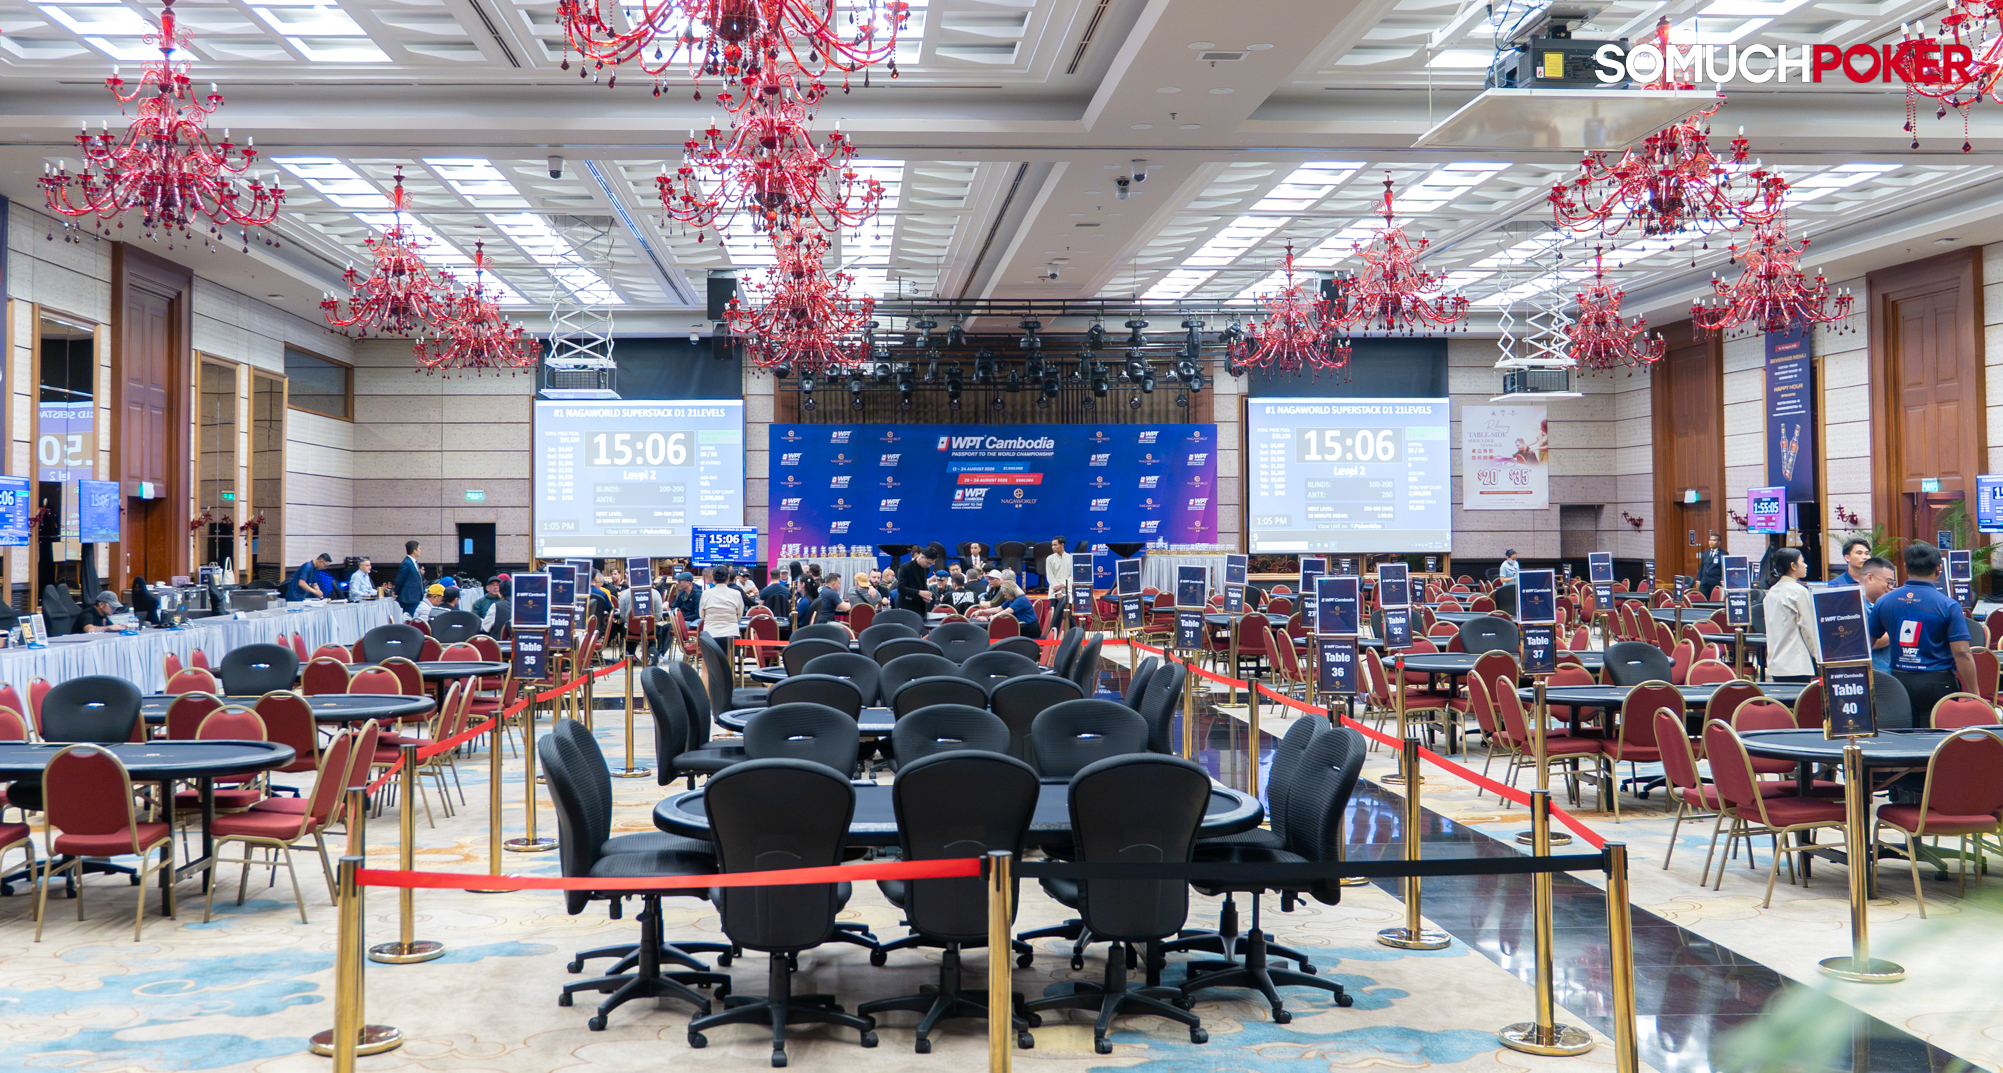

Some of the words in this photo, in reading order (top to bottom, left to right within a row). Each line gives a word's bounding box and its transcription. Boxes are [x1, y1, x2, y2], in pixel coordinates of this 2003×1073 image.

[554, 409, 564, 418] #1
[566, 409, 620, 418] NAGAWORLD
[622, 409, 673, 418] SUPERSTACK
[674, 409, 686, 418] D1
[687, 409, 725, 418] 21LEVELS
[1265, 406, 1276, 414] #1
[1277, 406, 1330, 414] NAGAWORLD
[1332, 406, 1381, 414] SUPERSTACK
[1383, 406, 1393, 414] D1
[1395, 406, 1431, 414] 21LEVELS
[952, 436, 985, 449] WPT
[986, 436, 1055, 449] Cambodia
[1304, 430, 1395, 461] 15:06
[593, 433, 687, 466] 15:06
[624, 470, 648, 481] Level
[650, 471, 656, 480] 2
[1334, 466, 1357, 477] Level
[1359, 467, 1366, 476] 2
[965, 488, 988, 497] WPT
[0, 491, 14, 506] :06
[1754, 502, 1779, 514] 1:55:05
[710, 534, 740, 544] 15:06
[1181, 620, 1199, 628] Table
[1527, 636, 1549, 645] Table
[519, 642, 542, 651] Table
[1325, 653, 1351, 662] Table
[1533, 650, 1544, 659] 37
[524, 656, 536, 665] 35
[1332, 667, 1344, 677] 36
[1832, 683, 1864, 696] Table
[1842, 703, 1858, 715] 40
